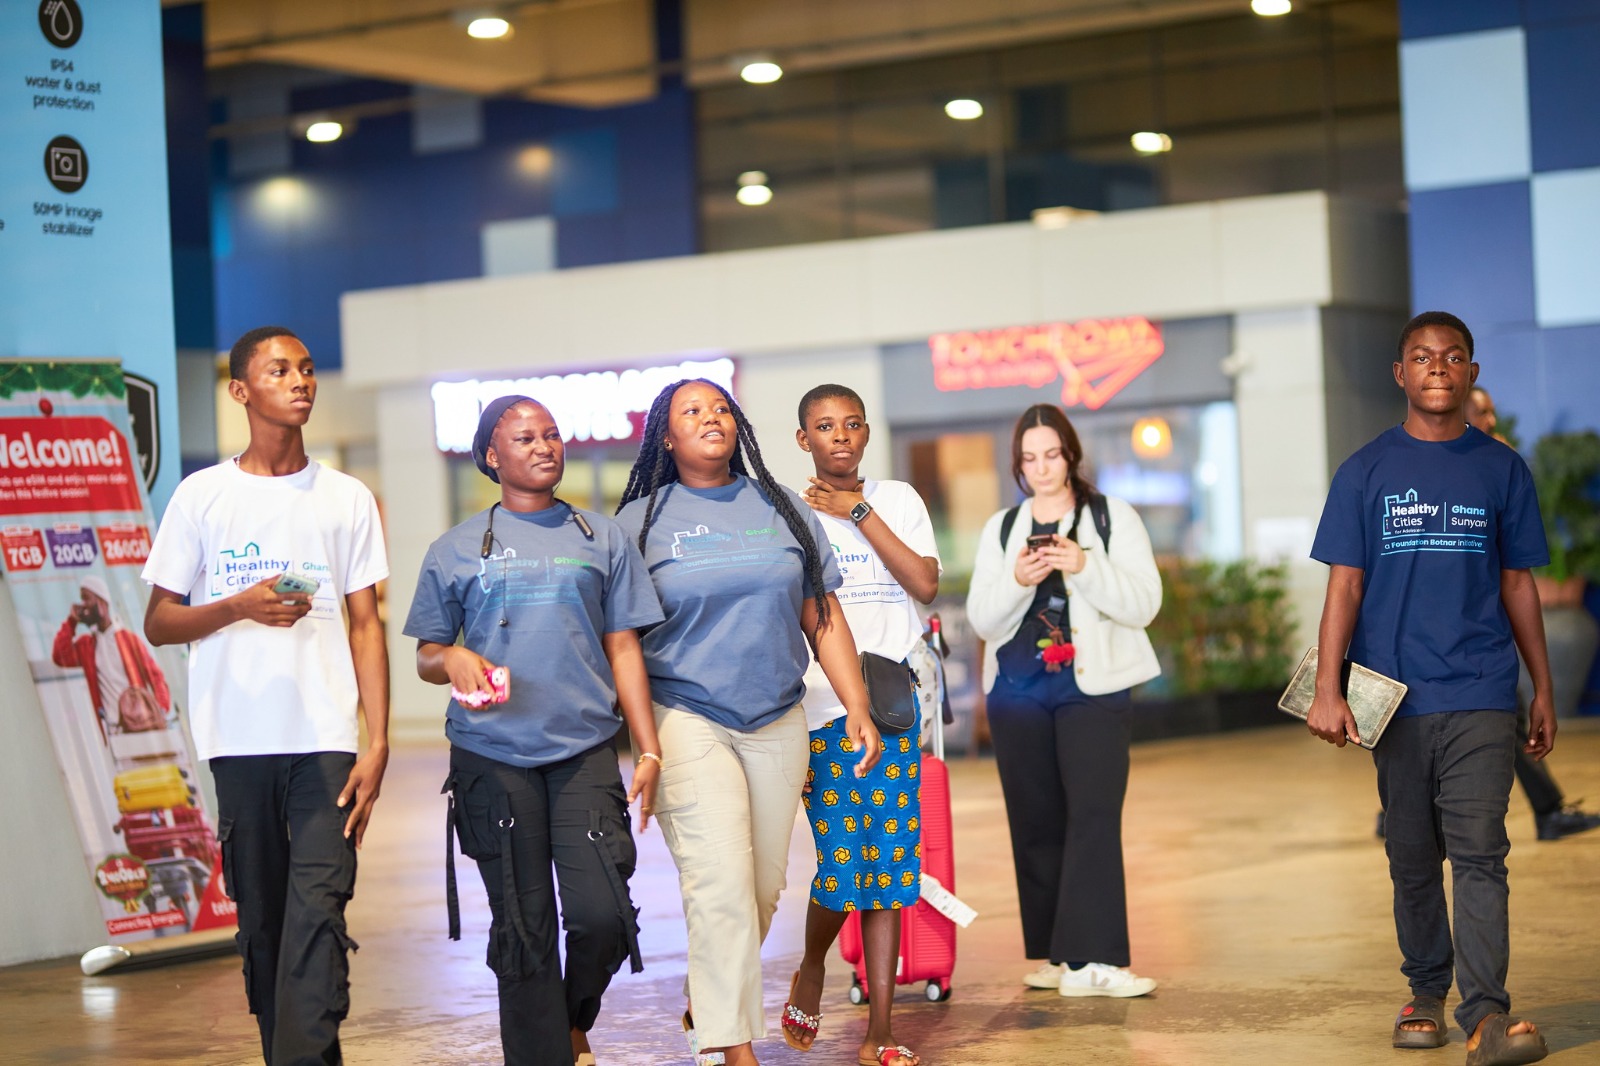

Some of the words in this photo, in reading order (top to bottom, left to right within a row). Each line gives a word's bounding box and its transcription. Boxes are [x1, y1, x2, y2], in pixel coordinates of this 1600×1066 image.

[50, 59, 74, 73] IP54
[25, 75, 61, 91] water
[64, 78, 73, 91] &
[75, 80, 102, 94] dust
[33, 94, 95, 111] protection
[33, 202, 62, 216] 50MP
[65, 204, 103, 222] image
[42, 220, 94, 237] stabilizer
[1391, 503, 1440, 517] Healthy
[1451, 505, 1485, 516] Ghana
[1393, 517, 1423, 528] Cities
[1451, 516, 1488, 529] Sunyani
[1391, 539, 1429, 548] Foundation
[8, 546, 43, 567] 7GB
[53, 543, 95, 565] 20GB
[837, 553, 869, 563] lthy
[226, 559, 290, 574] Healthy
[302, 561, 329, 571] Ghan
[850, 590, 879, 598] Botnar
